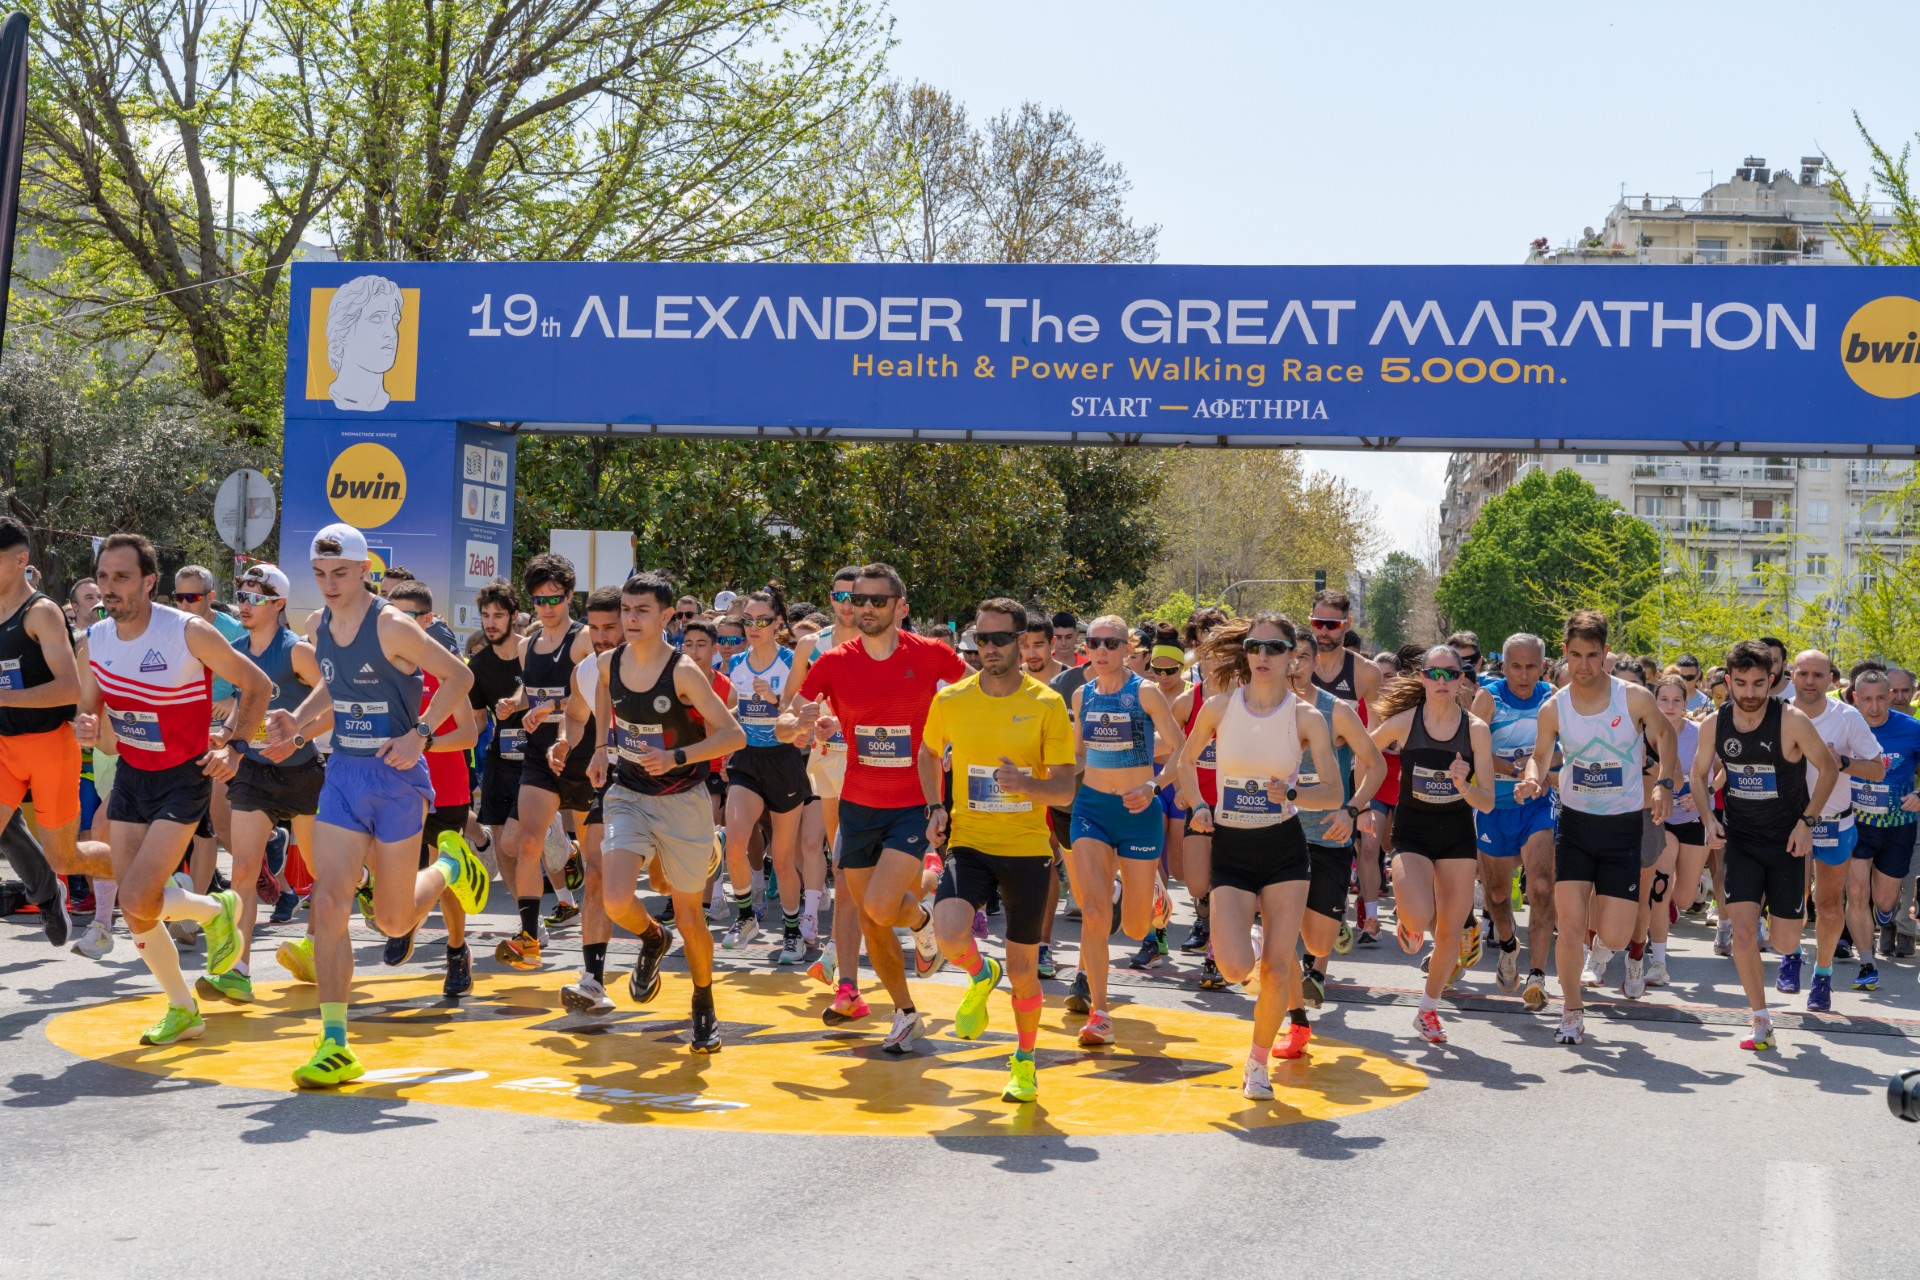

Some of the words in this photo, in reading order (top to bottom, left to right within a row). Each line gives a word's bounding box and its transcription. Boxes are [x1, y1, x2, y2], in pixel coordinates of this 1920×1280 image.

[468, 293, 560, 338] 19th
[571, 295, 963, 341] ALEXANDER
[986, 298, 1100, 342] The
[1121, 299, 1356, 345] GREAT
[1369, 300, 1817, 350] MARATHON
[852, 354, 958, 378] Health
[974, 356, 995, 378] &
[1011, 356, 1114, 380] Power
[1129, 357, 1265, 387] Walking
[1283, 359, 1364, 382] Race
[1380, 358, 1567, 383] 5.000m.
[1071, 397, 1152, 418] START
[1193, 399, 1330, 420] ΑΦΕΤΗΡΙΑ
[329, 472, 401, 500] bwin
[746, 704, 767, 712] 50377
[345, 720, 372, 730] 57730
[122, 725, 146, 736] 51140
[1093, 726, 1118, 736] 50035
[868, 741, 896, 751] 50064
[1584, 773, 1608, 782] 50001
[1738, 777, 1763, 786] 50002
[1425, 781, 1453, 790] 50033
[1236, 794, 1267, 806] 50032
